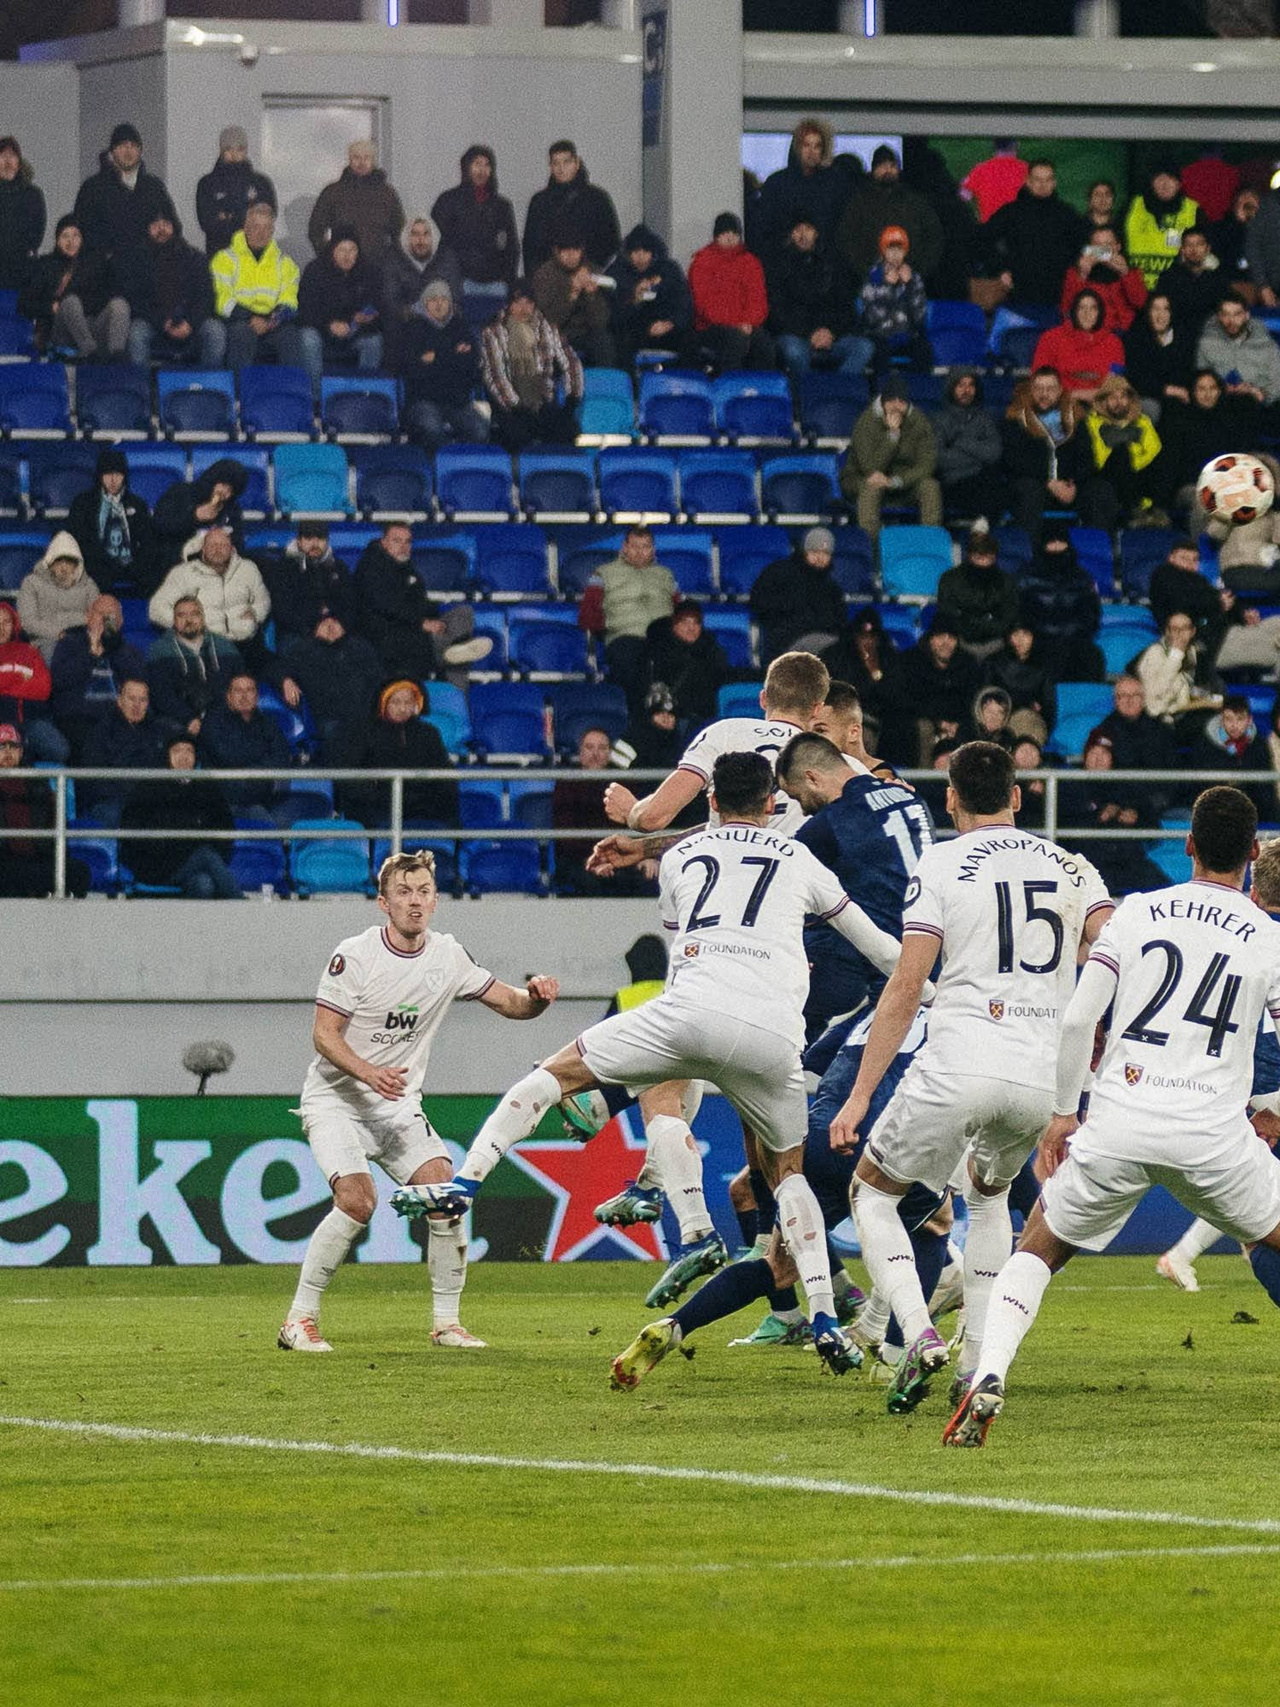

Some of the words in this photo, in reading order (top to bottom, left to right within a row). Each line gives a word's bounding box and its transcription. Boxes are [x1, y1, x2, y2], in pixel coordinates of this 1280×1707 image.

[958, 838, 1087, 888] MAVROPANOS
[681, 854, 781, 934] 27
[994, 880, 1064, 974] 15
[1149, 899, 1257, 943] KEHRER
[702, 944, 772, 960] FOUNDATION
[1120, 938, 1243, 1058] 24
[1145, 1073, 1218, 1095] FOUNDATION
[805, 1274, 826, 1284] WHU
[1002, 1294, 1030, 1316] WHU
